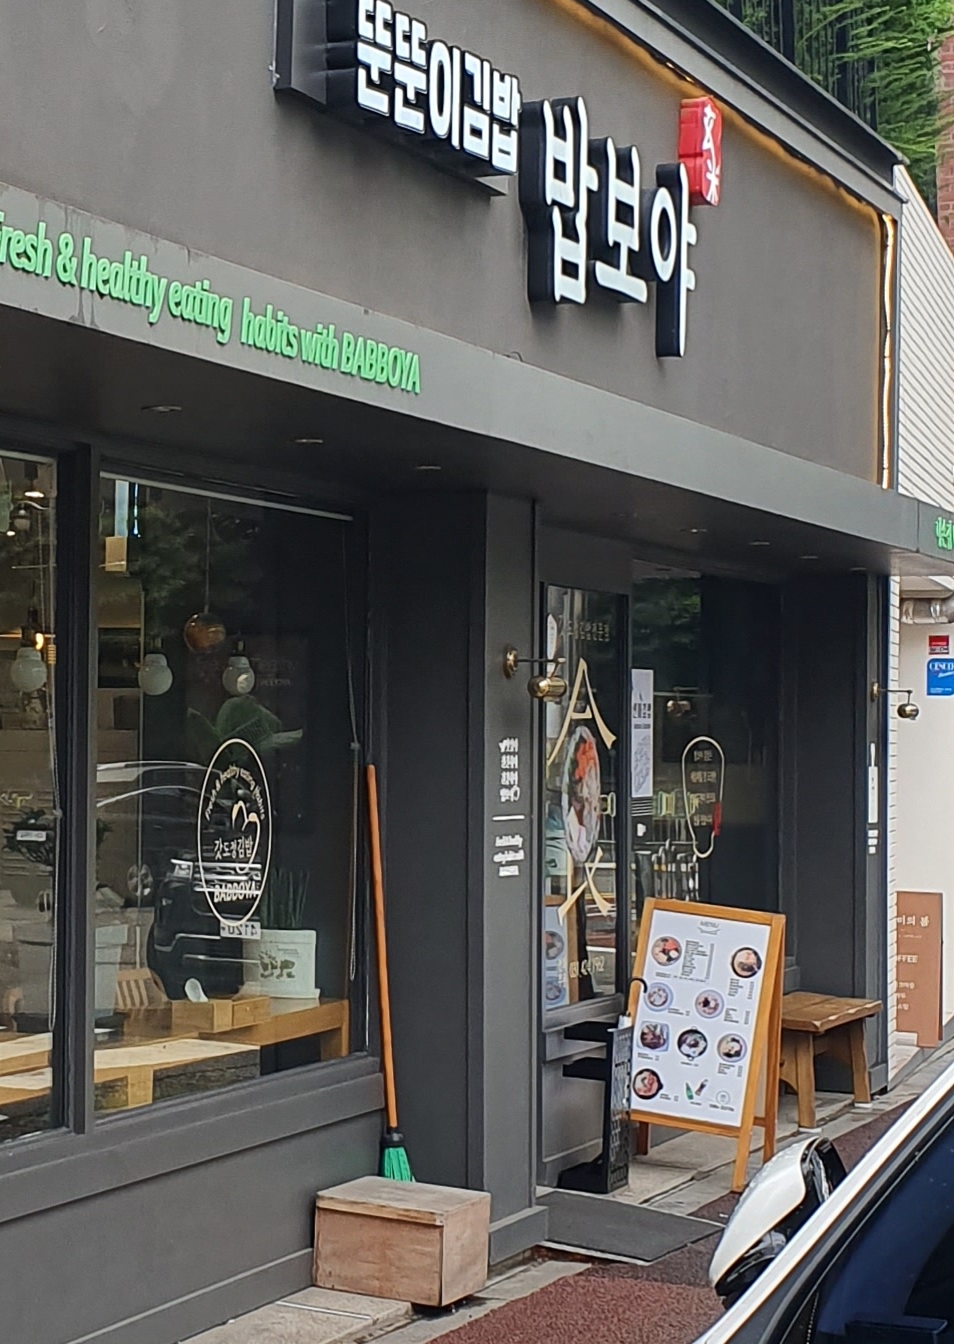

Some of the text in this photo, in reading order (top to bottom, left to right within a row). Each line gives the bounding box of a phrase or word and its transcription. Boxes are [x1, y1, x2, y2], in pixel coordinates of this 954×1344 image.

[56, 232, 78, 286] &
[80, 236, 168, 324] healthy
[168, 279, 234, 344] eating
[240, 297, 299, 358] habits
[300, 323, 339, 370] with
[340, 332, 421, 394] BABBOYA
[545, 96, 698, 357] 밥보야
